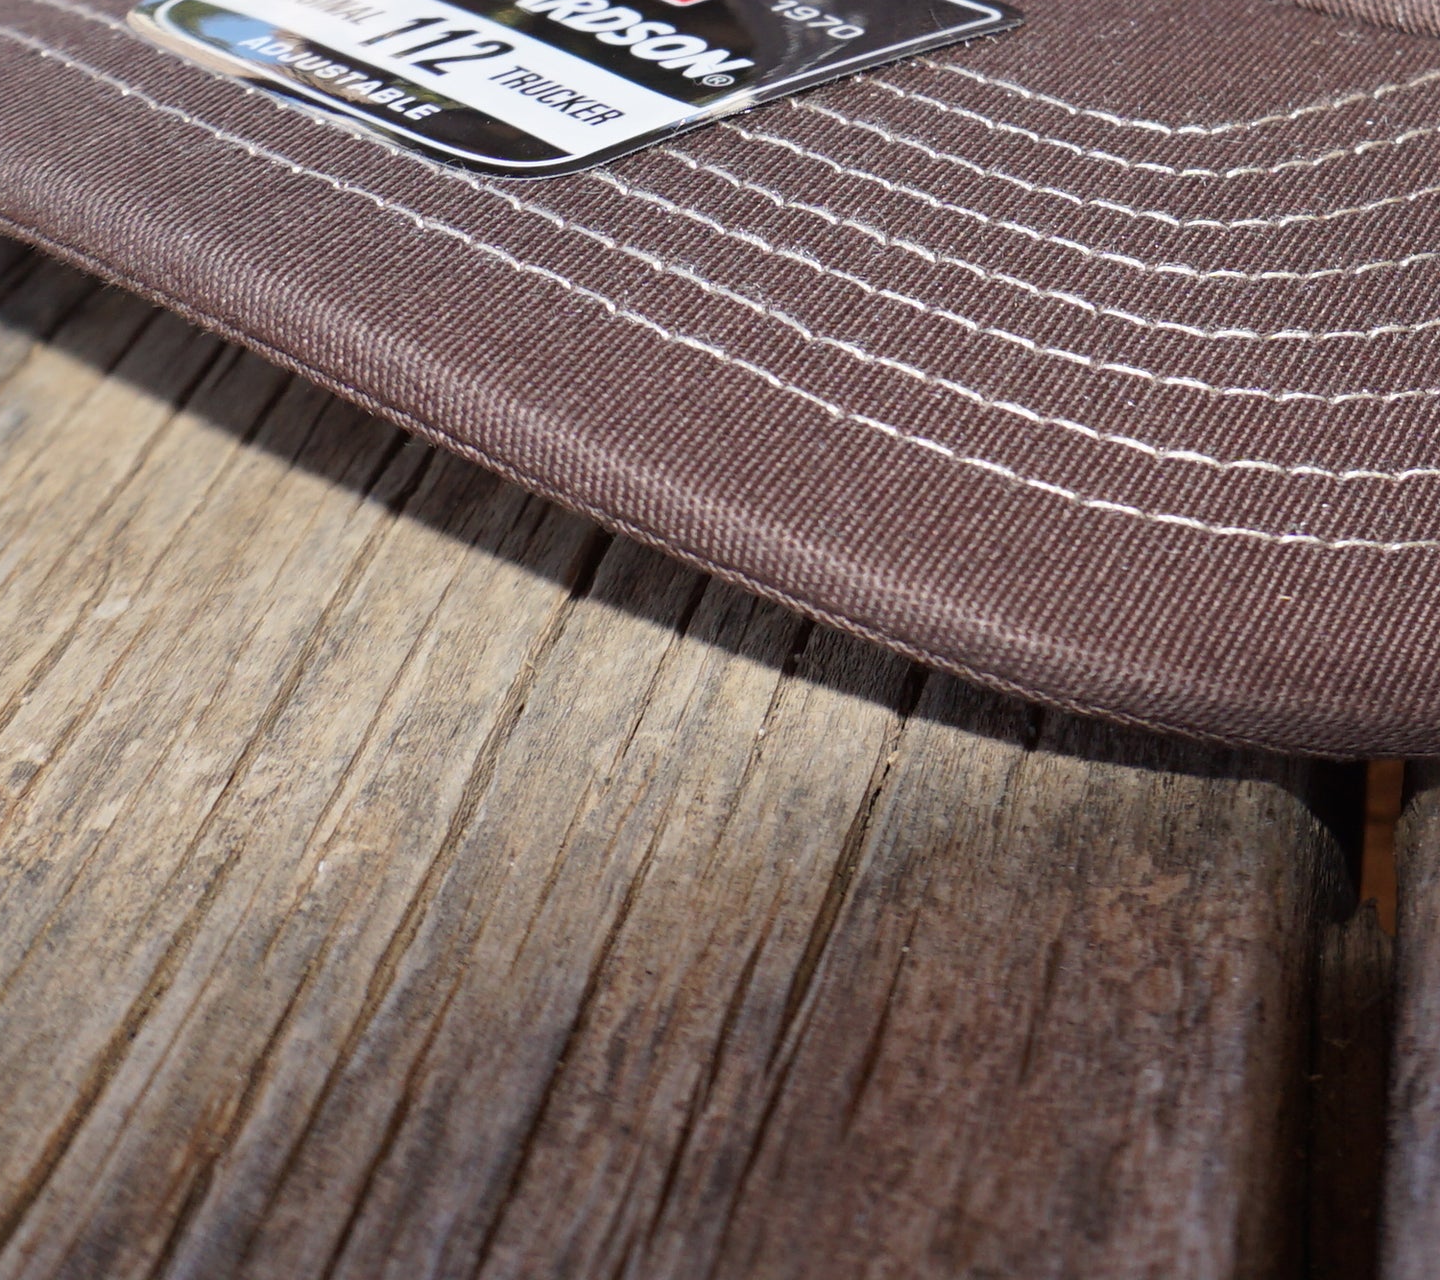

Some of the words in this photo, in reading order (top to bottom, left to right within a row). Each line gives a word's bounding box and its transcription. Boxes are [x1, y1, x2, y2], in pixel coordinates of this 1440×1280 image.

[237, 36, 444, 122] ADJUSTABLE
[359, 16, 517, 77] 112
[486, 64, 627, 127] TRUCKER
